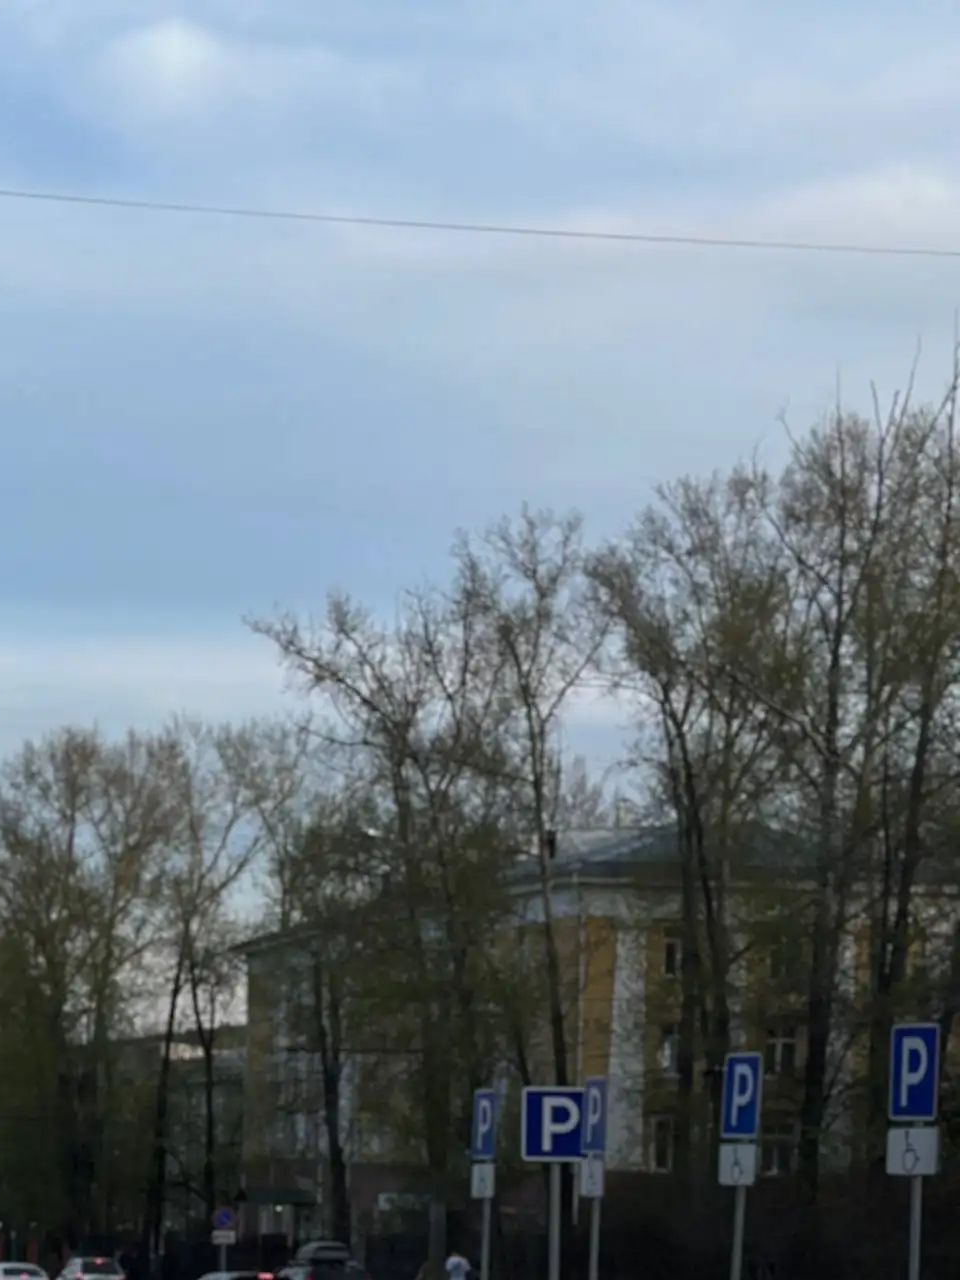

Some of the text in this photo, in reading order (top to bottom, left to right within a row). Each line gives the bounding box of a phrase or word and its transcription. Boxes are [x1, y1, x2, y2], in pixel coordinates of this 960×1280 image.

[731, 1063, 755, 1128] P
[899, 1036, 929, 1108] P
[477, 1099, 492, 1150] P
[540, 1095, 580, 1152] P
[586, 1086, 602, 1144] P
